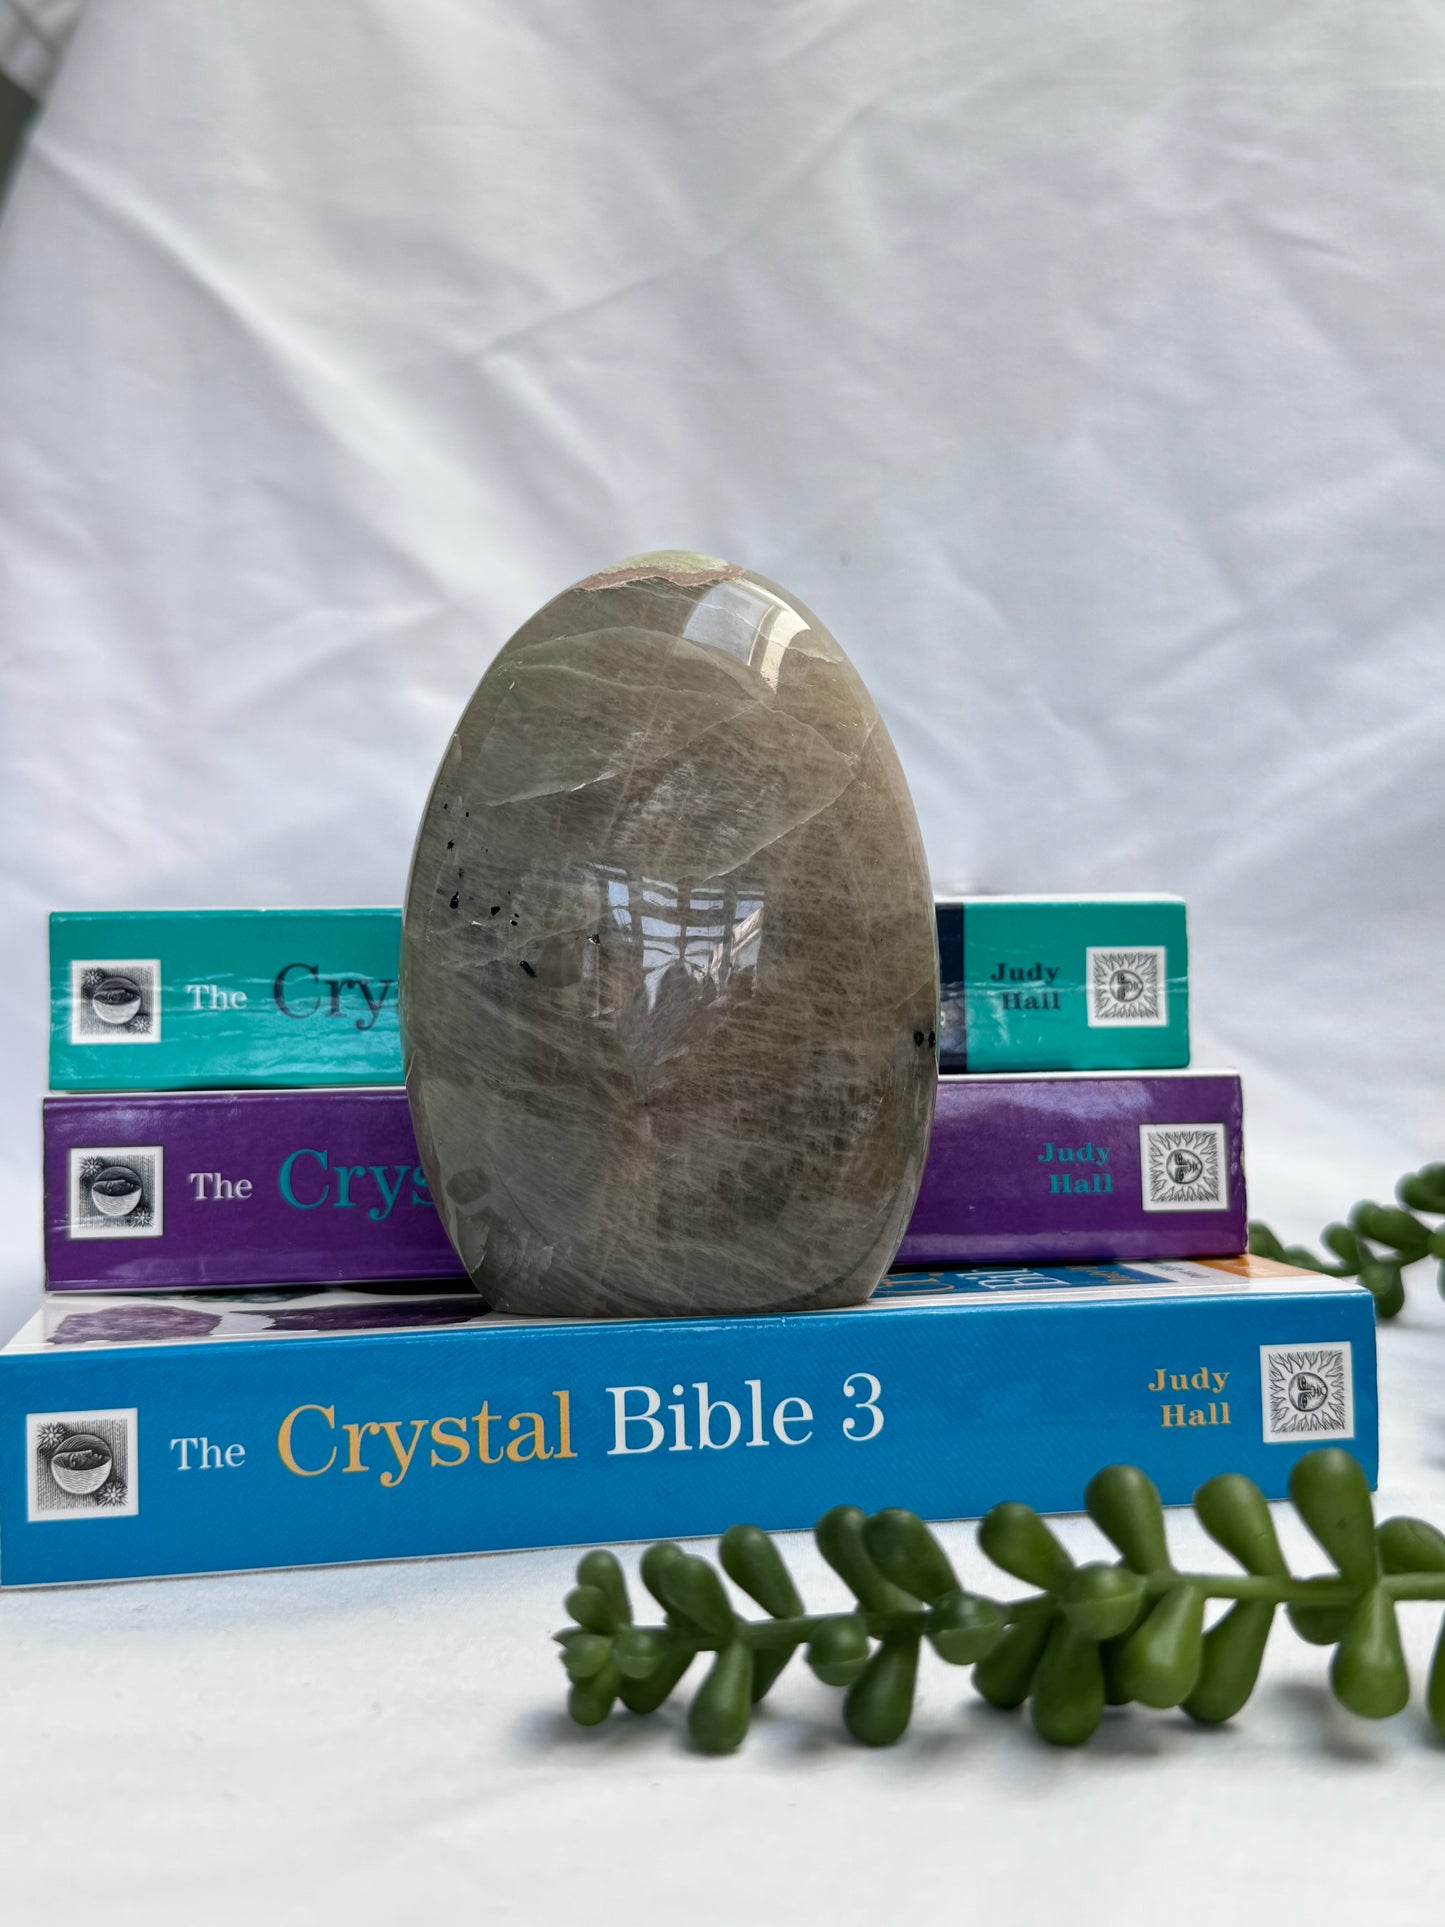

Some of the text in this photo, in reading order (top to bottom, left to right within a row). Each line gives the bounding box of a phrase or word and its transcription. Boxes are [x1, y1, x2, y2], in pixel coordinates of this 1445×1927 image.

[989, 963, 1060, 983] Judy
[187, 963, 398, 1030] The Cry
[1001, 991, 1061, 1011] Hall
[1038, 1143, 1111, 1165] Judy
[188, 1172, 254, 1201] The
[1050, 1173, 1113, 1195] Hall
[1148, 1366, 1231, 1394] Judy
[1160, 1401, 1232, 1429] Hall
[170, 1372, 885, 1488] The Crystal Bible 3
